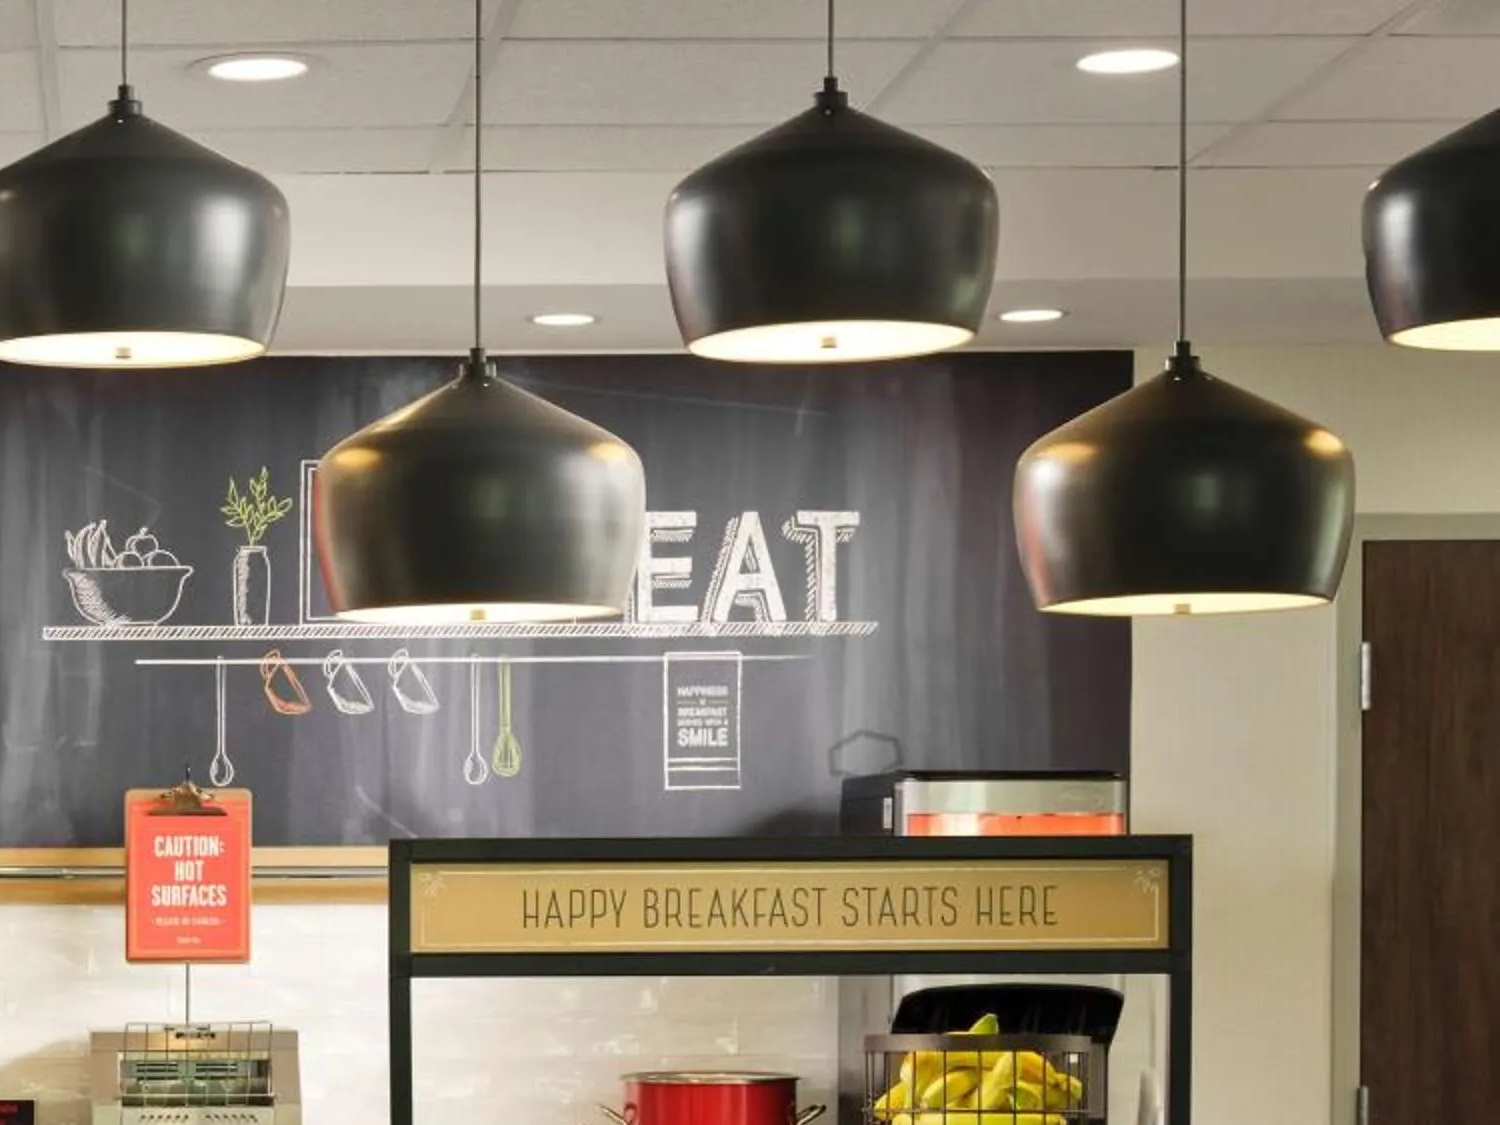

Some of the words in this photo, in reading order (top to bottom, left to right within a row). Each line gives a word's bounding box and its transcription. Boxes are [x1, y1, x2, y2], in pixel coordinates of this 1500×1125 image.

[626, 510, 861, 634] EAT
[677, 727, 728, 747] SMILE
[153, 834, 226, 858] CAUTION:
[174, 859, 205, 882] HOT
[151, 883, 227, 908] SURFACES
[522, 889, 627, 929] HAPPY
[643, 887, 827, 928] BREAKFAST
[841, 886, 958, 927] STARTS
[976, 885, 1059, 926] HERE
